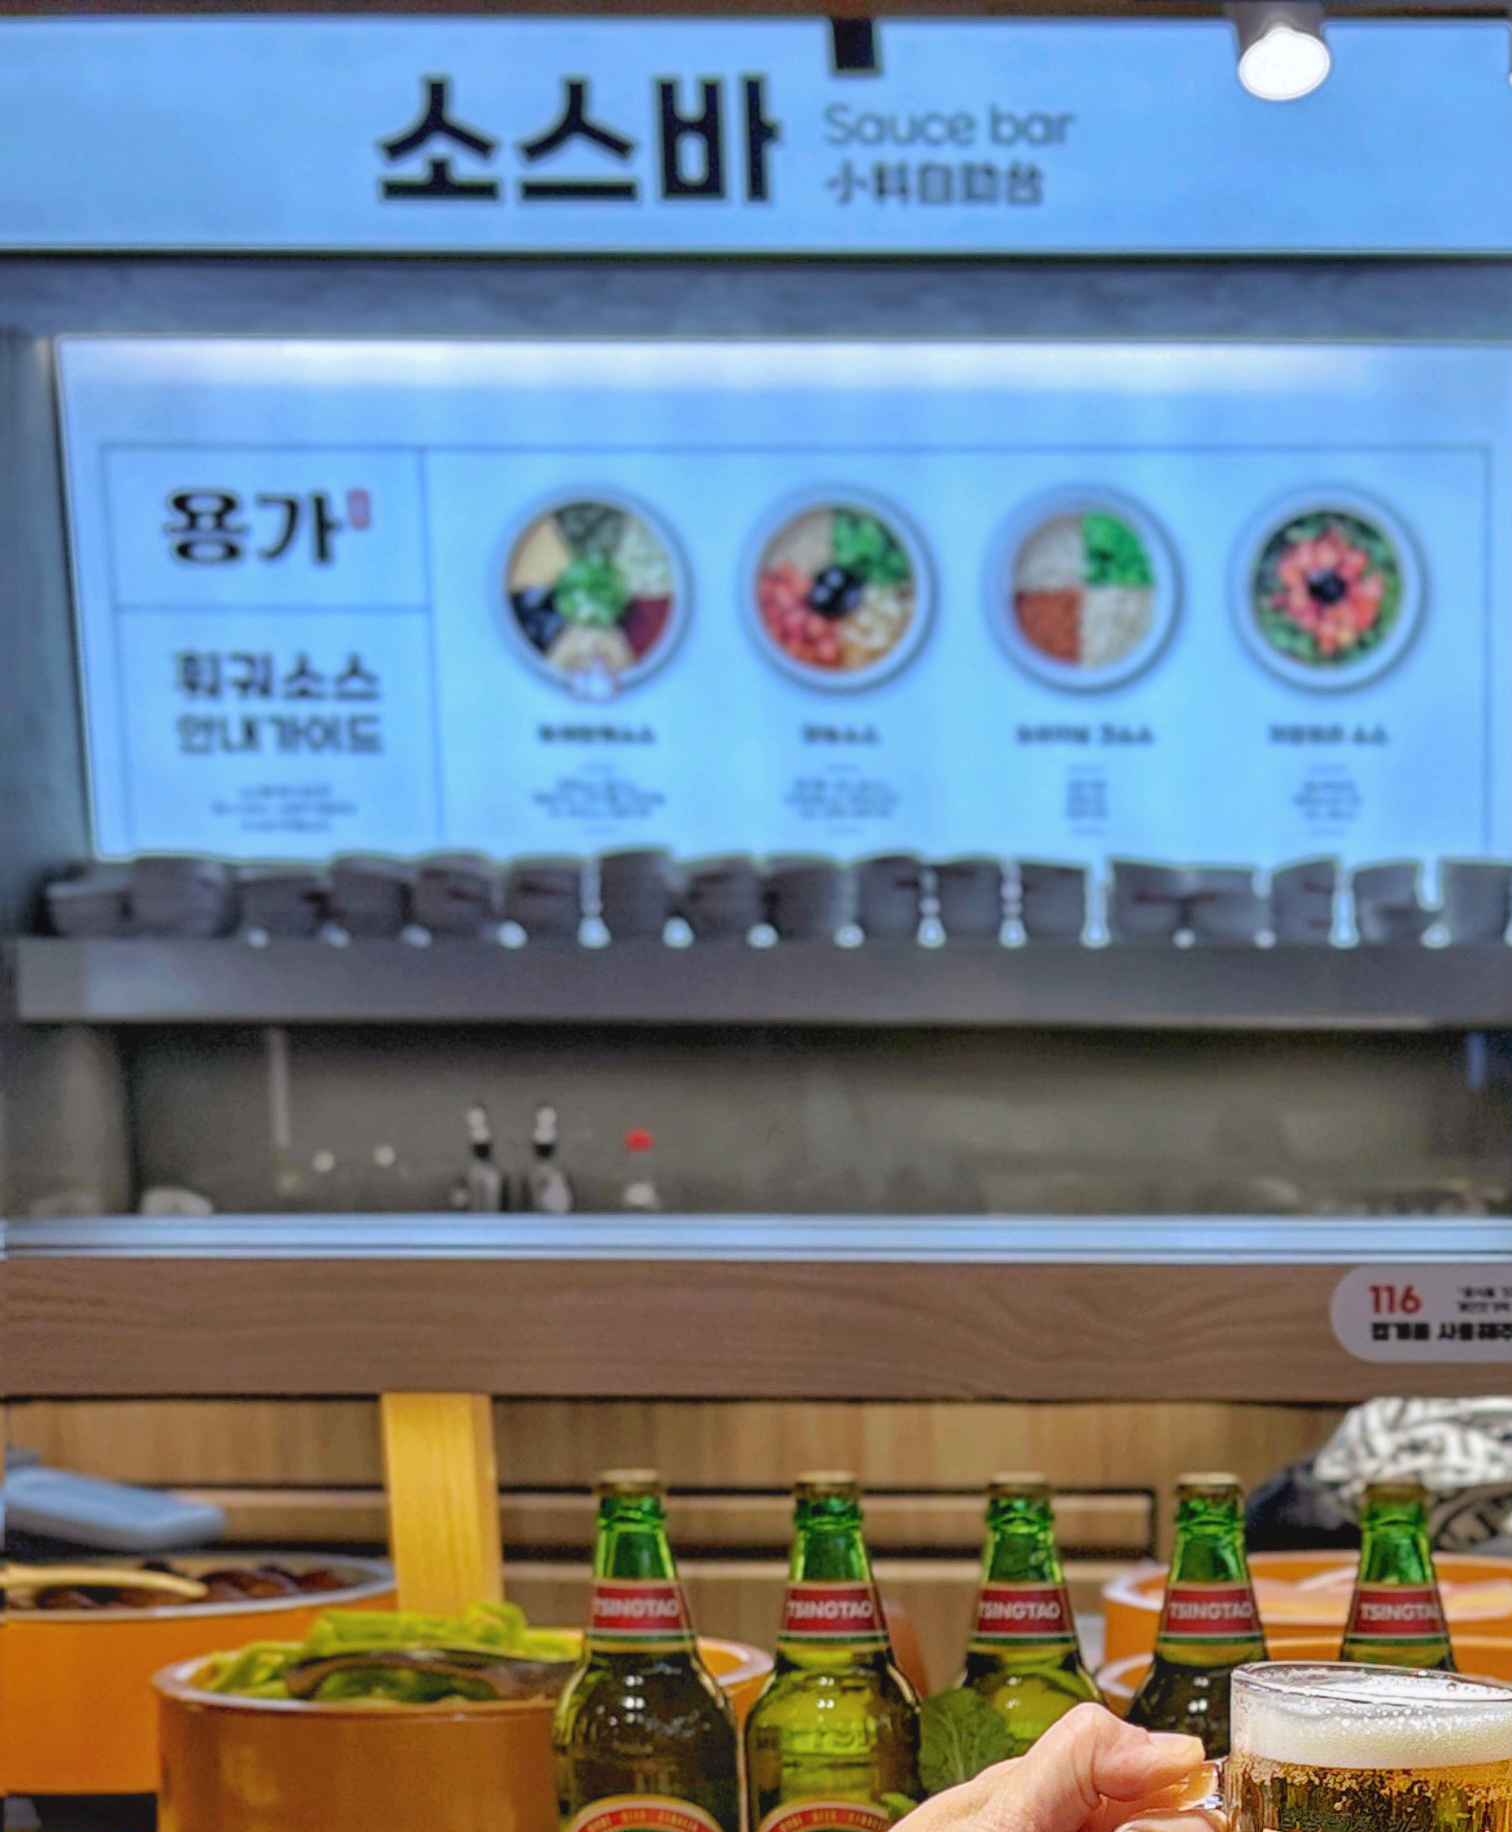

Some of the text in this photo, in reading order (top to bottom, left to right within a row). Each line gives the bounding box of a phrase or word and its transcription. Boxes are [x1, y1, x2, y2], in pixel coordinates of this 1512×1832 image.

[378, 73, 779, 203] 소스바
[823, 100, 1077, 146] Sauce bar
[162, 488, 344, 566] 용가
[1369, 1284, 1421, 1315] 116
[594, 1597, 679, 1619] TSINGTAO
[787, 1600, 873, 1620] TSINGTAO
[1360, 1603, 1440, 1621] TSINGTA
